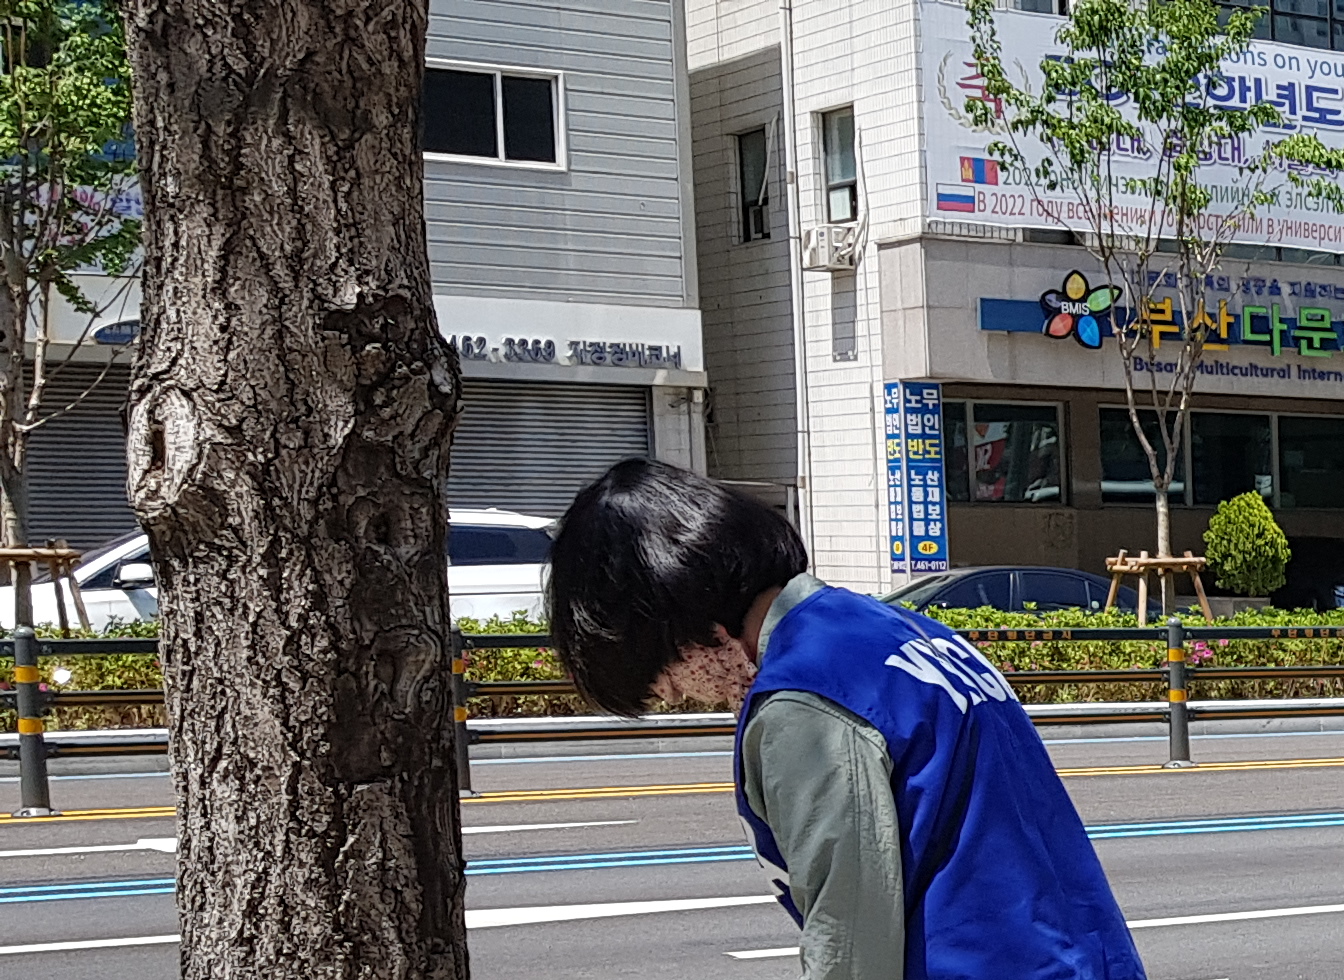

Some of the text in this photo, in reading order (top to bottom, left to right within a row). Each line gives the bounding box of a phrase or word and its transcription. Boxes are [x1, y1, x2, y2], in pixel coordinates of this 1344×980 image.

[1273, 53, 1301, 72] on
[977, 191, 987, 213] В
[991, 192, 1026, 217] 2022
[1030, 198, 1063, 225] году
[1267, 216, 1275, 233] в
[1061, 302, 1091, 315] BMIS
[905, 388, 939, 410] 노무
[906, 413, 940, 435] 법인
[907, 438, 941, 460] 반도
[920, 543, 934, 553] 4F
